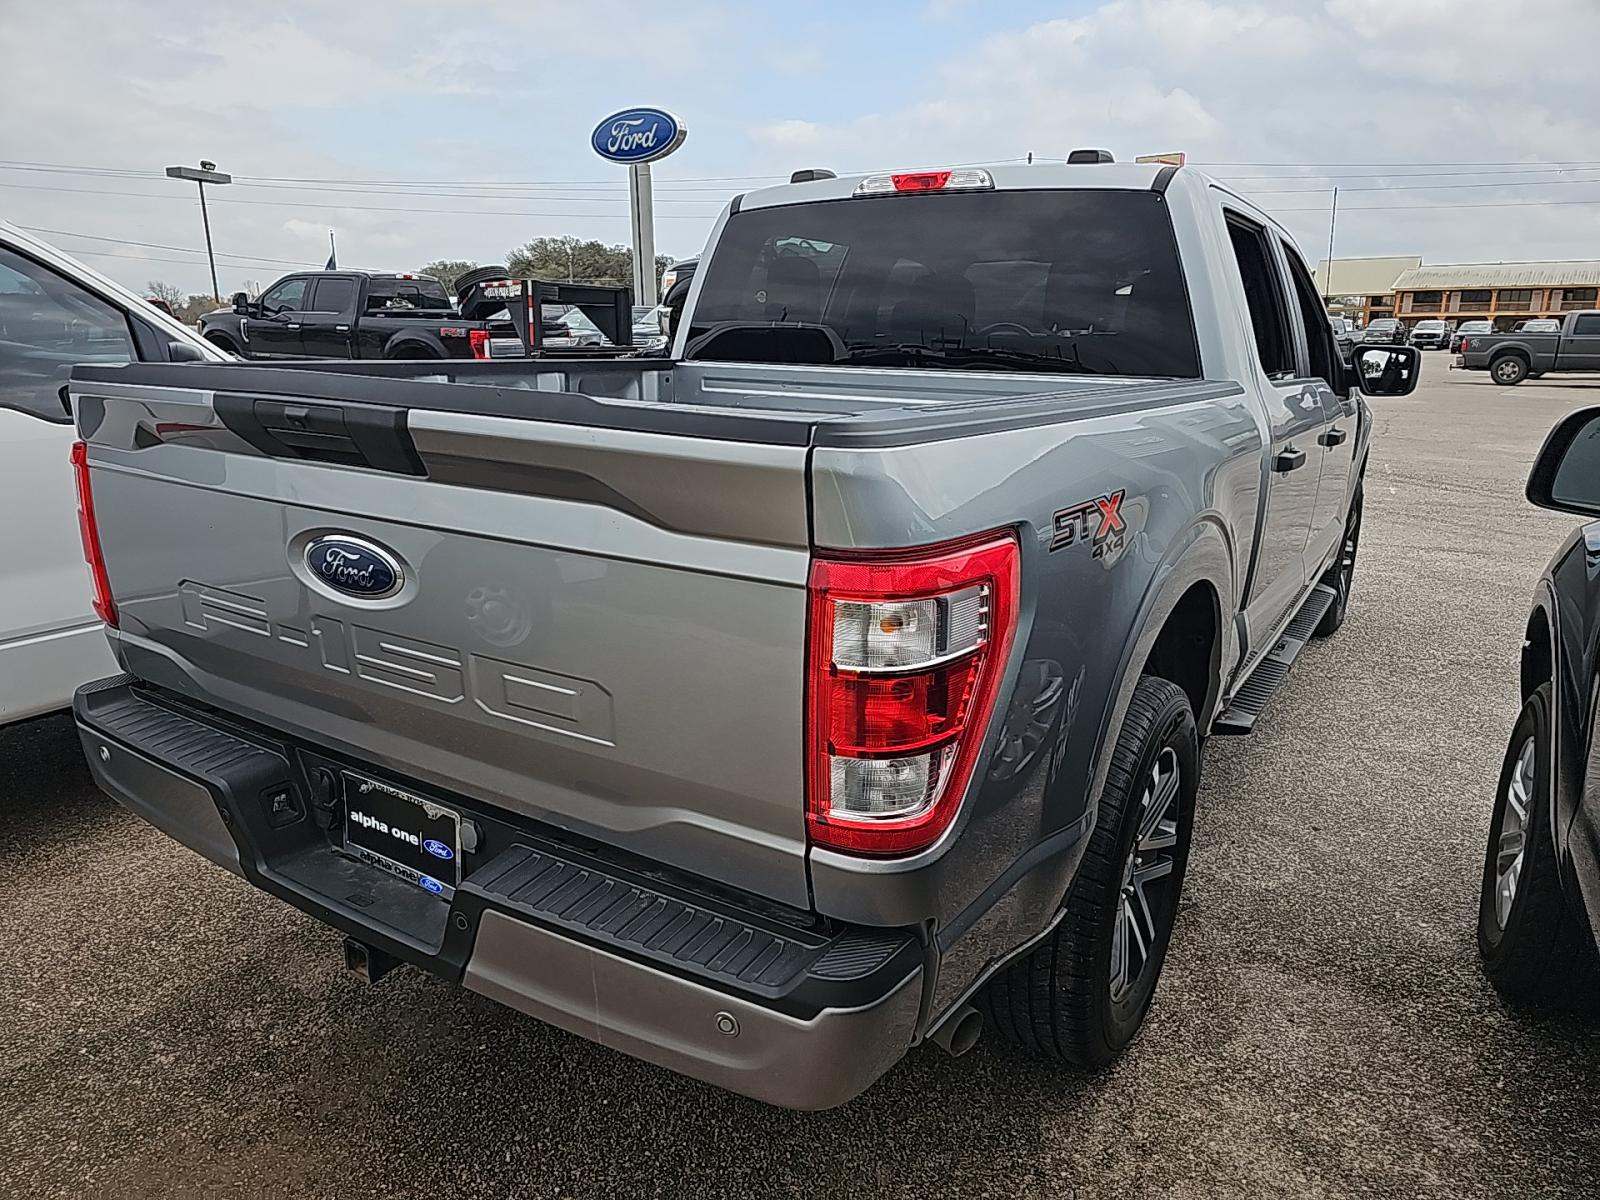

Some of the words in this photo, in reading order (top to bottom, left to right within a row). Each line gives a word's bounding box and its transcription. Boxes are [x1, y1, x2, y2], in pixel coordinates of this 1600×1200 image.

[607, 118, 659, 153] Ford
[1049, 488, 1127, 553] STX
[322, 548, 375, 588] Ford
[178, 578, 616, 747] F-150
[350, 810, 389, 834] alpha
[391, 827, 419, 846] one
[360, 850, 392, 871] alpha
[394, 866, 418, 880] one
[428, 841, 449, 857] Ford
[423, 877, 440, 892] Ford
